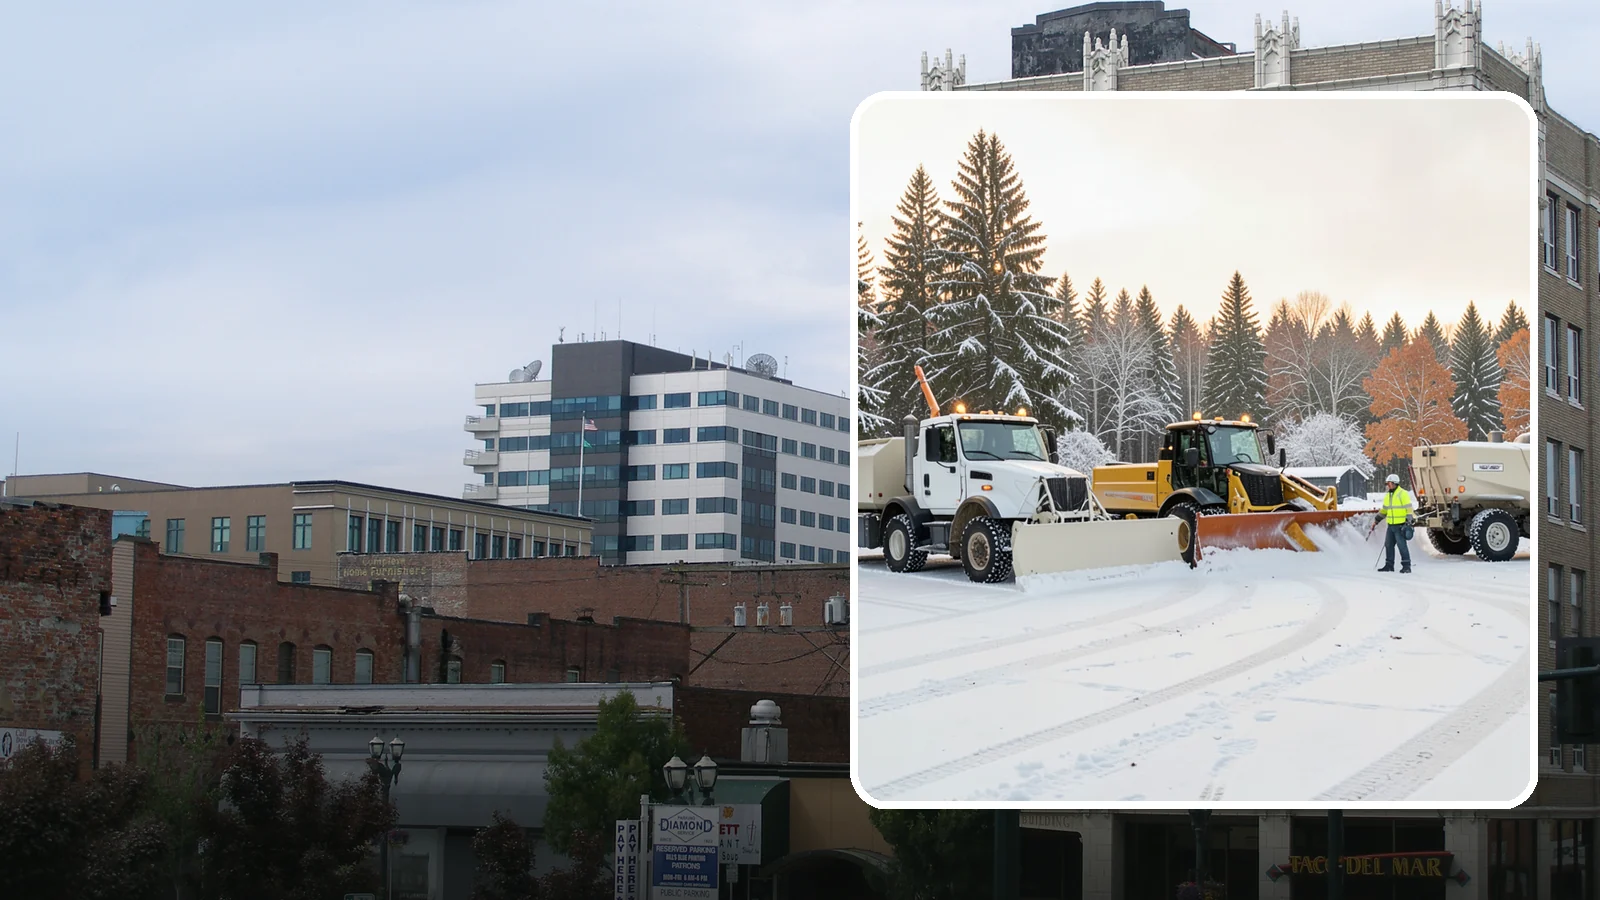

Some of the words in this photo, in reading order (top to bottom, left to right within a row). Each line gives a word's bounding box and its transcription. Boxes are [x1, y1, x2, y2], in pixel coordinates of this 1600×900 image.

[343, 568, 368, 577] Home
[370, 566, 427, 576] Furnishers
[660, 818, 713, 832] DIAMOND
[1021, 815, 1070, 827] BUILDING
[628, 824, 637, 852] PAY
[656, 845, 688, 853] RESERVED
[689, 846, 716, 854] PARKING
[1346, 856, 1384, 877] DEL
[1392, 857, 1442, 877] MAR
[616, 856, 624, 893] HERE
[627, 856, 636, 893] HERE
[660, 889, 682, 897] PUBLIC
[683, 889, 710, 898] PARKING
